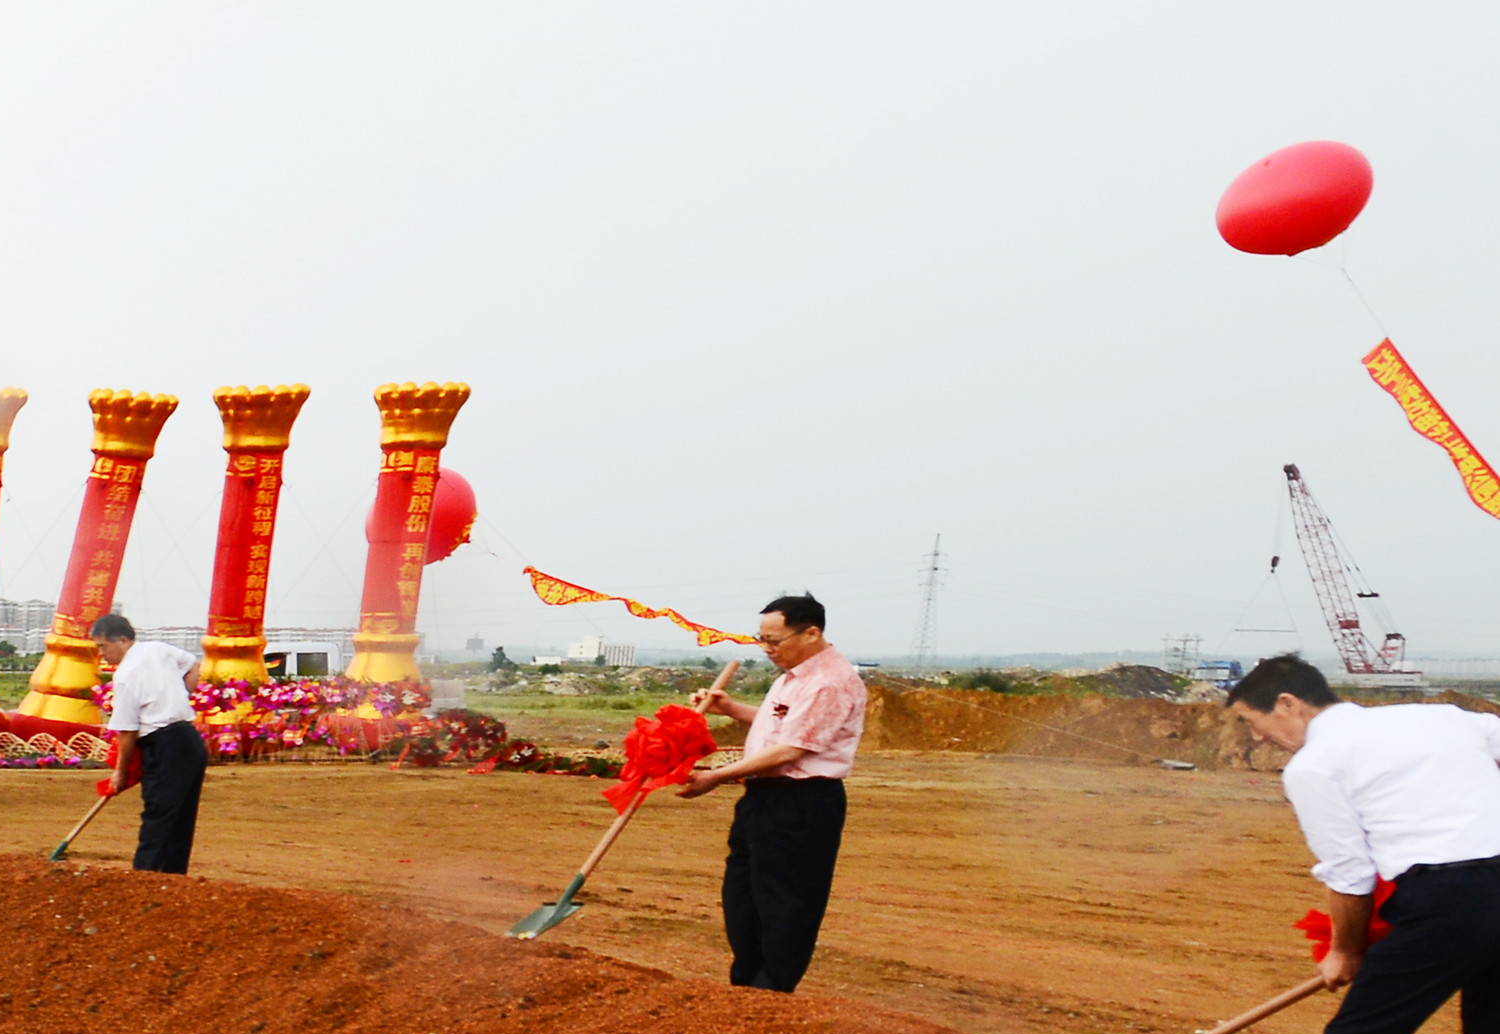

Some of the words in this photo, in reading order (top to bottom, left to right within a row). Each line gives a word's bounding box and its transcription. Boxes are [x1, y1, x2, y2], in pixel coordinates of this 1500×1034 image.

[97, 465, 137, 540] 团结奋进
[252, 459, 280, 536] 开启新征程
[405, 456, 437, 532] 康泰股份
[243, 544, 269, 619] 实现新跨越
